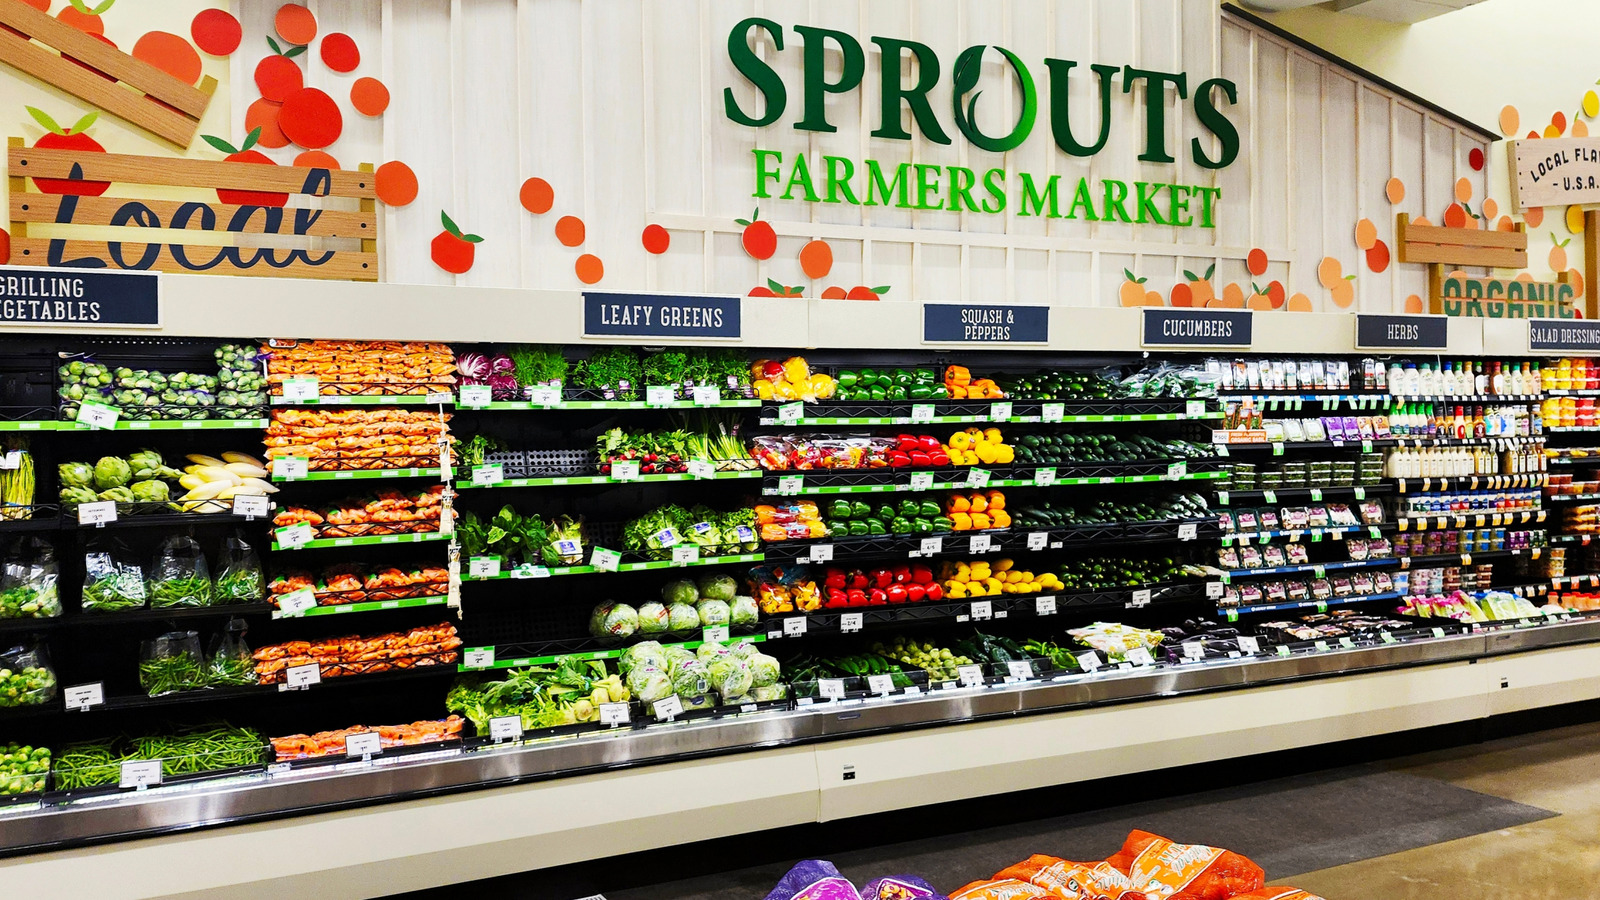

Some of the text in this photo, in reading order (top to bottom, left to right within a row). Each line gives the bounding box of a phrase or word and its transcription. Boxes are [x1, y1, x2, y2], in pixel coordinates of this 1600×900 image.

[723, 17, 1240, 170] SPROUTS
[1530, 147, 1600, 183] LOCAL FLA
[751, 148, 1222, 229] FARMERS MARKET
[47, 161, 337, 271] Local
[1443, 277, 1574, 318] ORGANIC
[0, 299, 100, 321] GETABLES
[600, 304, 723, 328] LEAFY GREENS
[961, 308, 1014, 326] SQUASH &
[964, 325, 1010, 341] PEPPERS
[1163, 319, 1233, 338] CUCUMBERS
[1387, 324, 1419, 340] HERBS
[1531, 327, 1558, 343] SALAD
